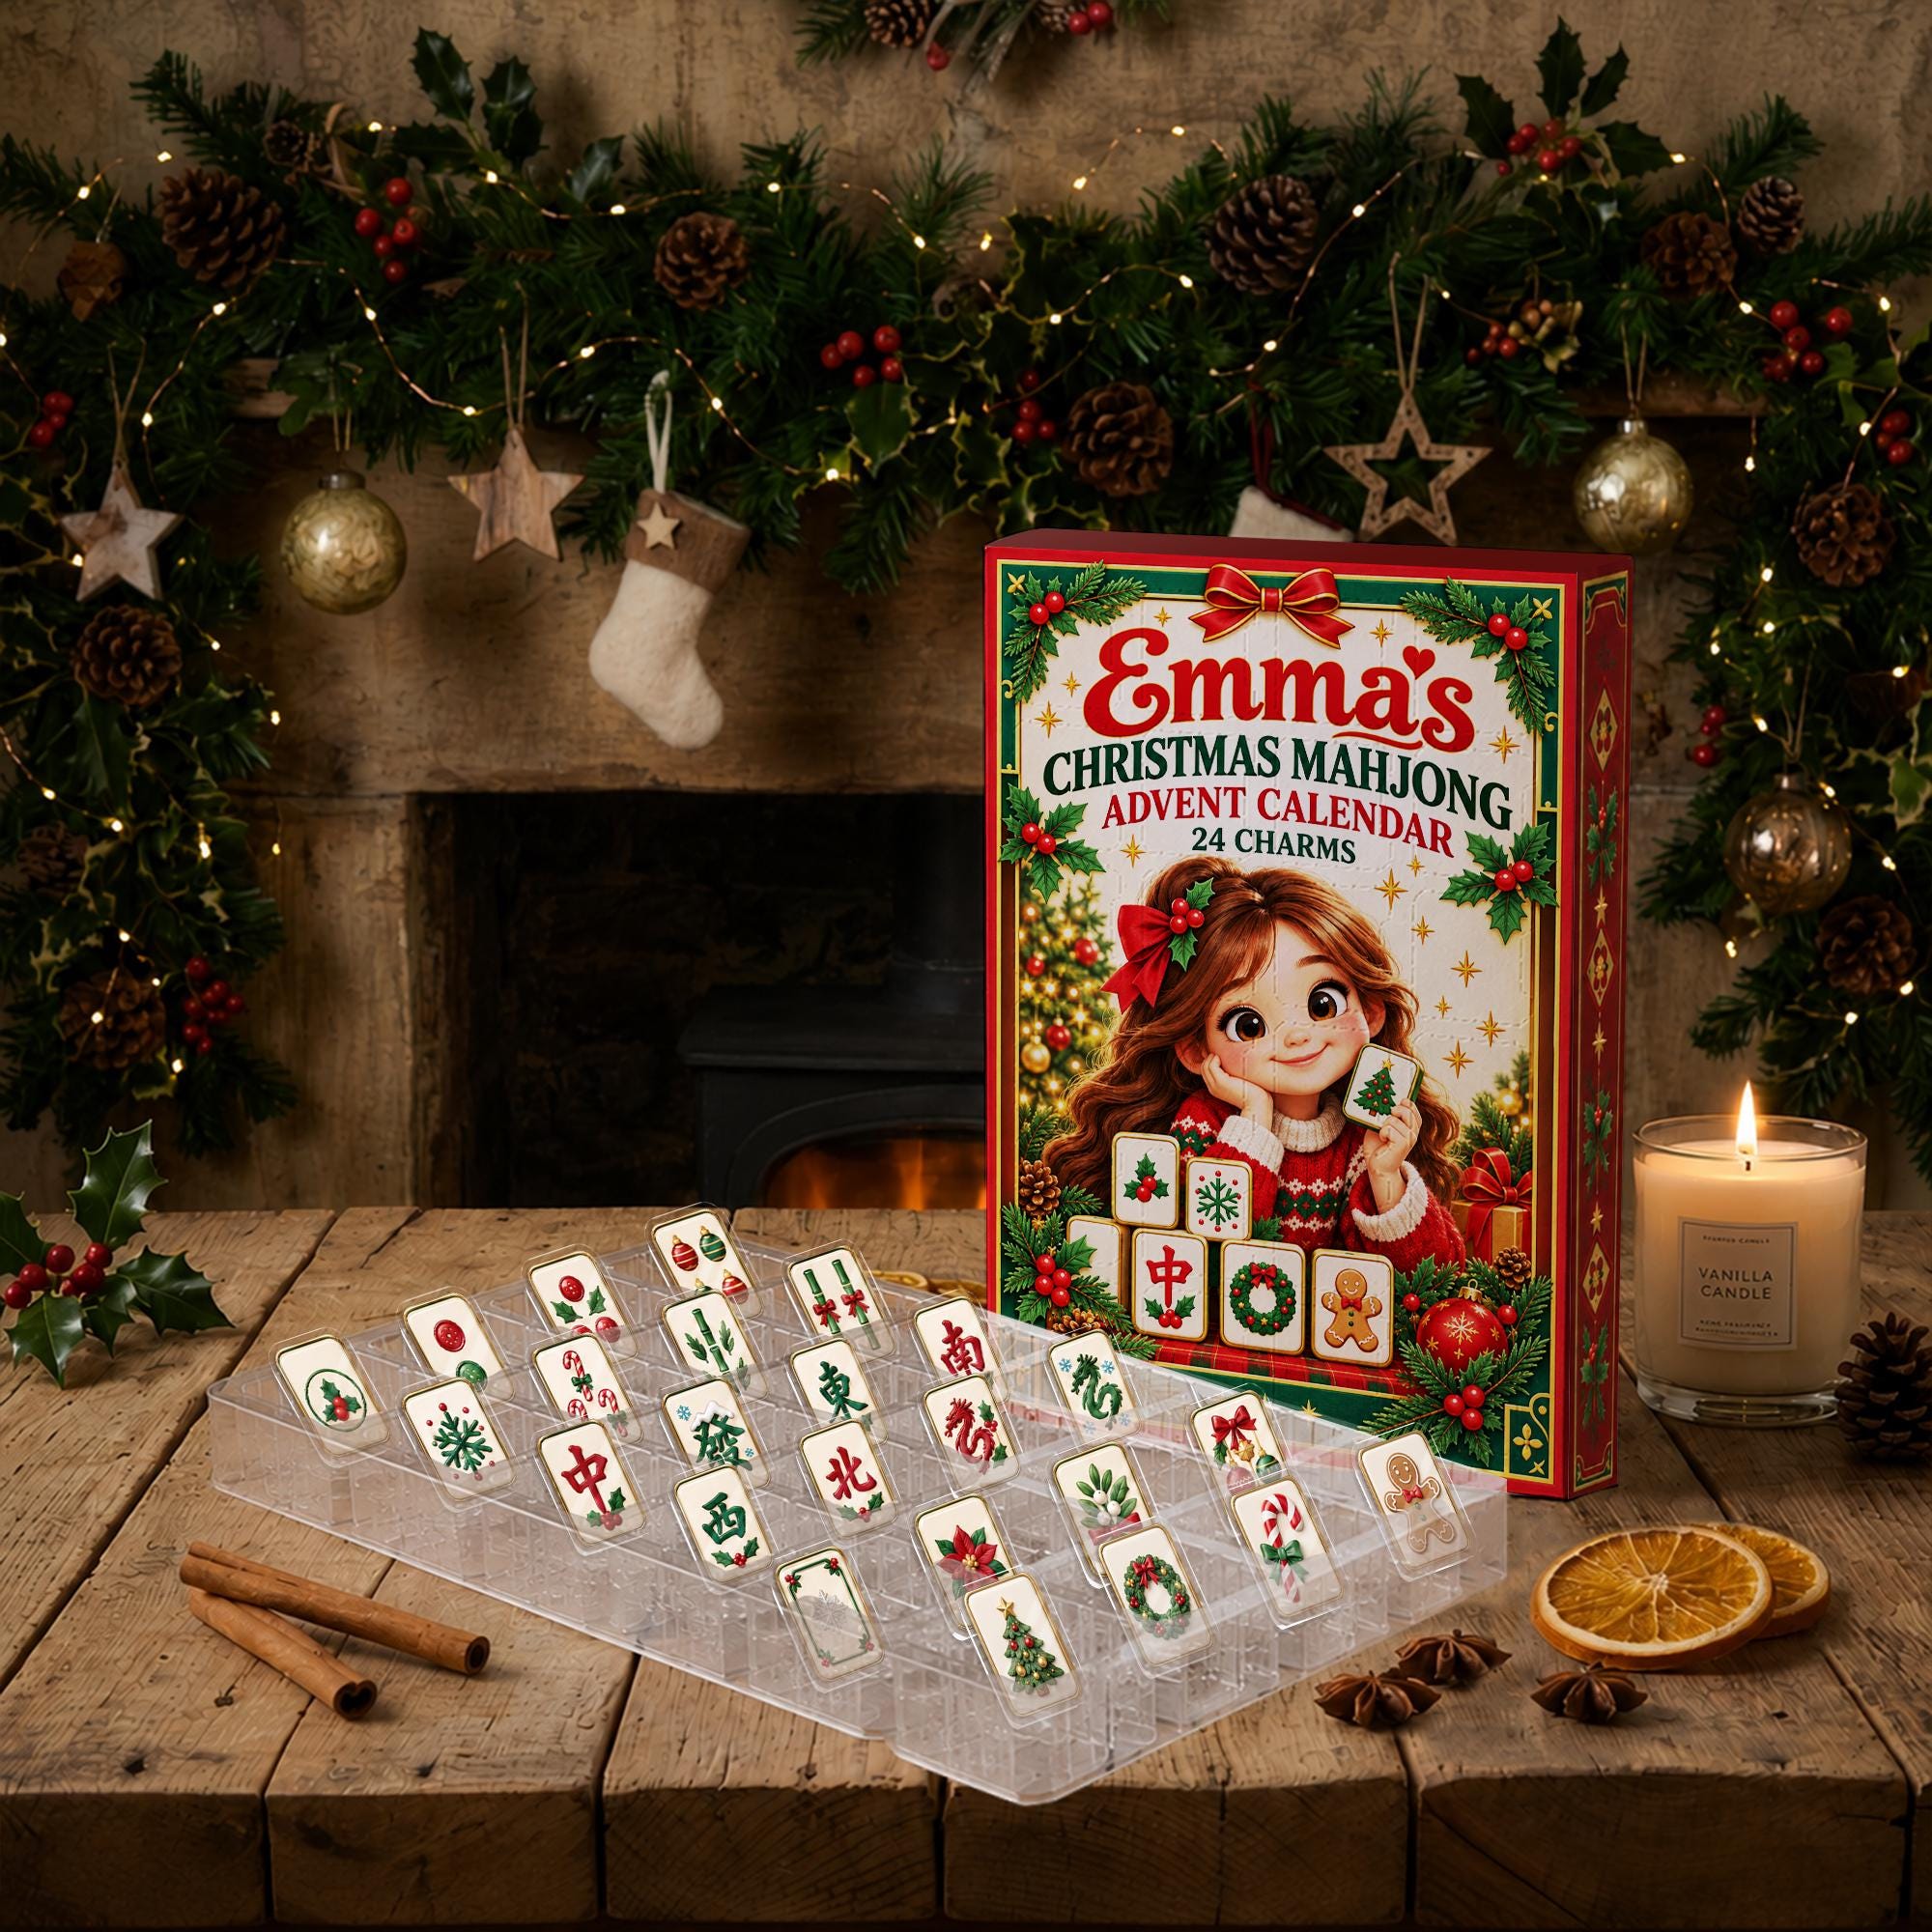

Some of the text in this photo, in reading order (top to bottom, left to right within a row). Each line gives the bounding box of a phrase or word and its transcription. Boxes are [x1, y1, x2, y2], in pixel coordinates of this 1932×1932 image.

[1083, 628, 1475, 753] Emma's
[1044, 736, 1514, 831] CHRISTMAS MAHJONG
[1101, 787, 1456, 858] ADVENT CALENDAR
[1191, 827, 1356, 865] 24 CHARMS
[1146, 1244, 1194, 1308] 中
[1698, 1267, 1774, 1282] VANILLA
[1700, 1285, 1772, 1299] CANDLE
[941, 1320, 985, 1377] 南
[818, 1360, 868, 1422] 東
[694, 1411, 753, 1470] 發
[560, 1445, 609, 1514] 中
[826, 1446, 877, 1500] 北
[702, 1492, 748, 1545] 西
